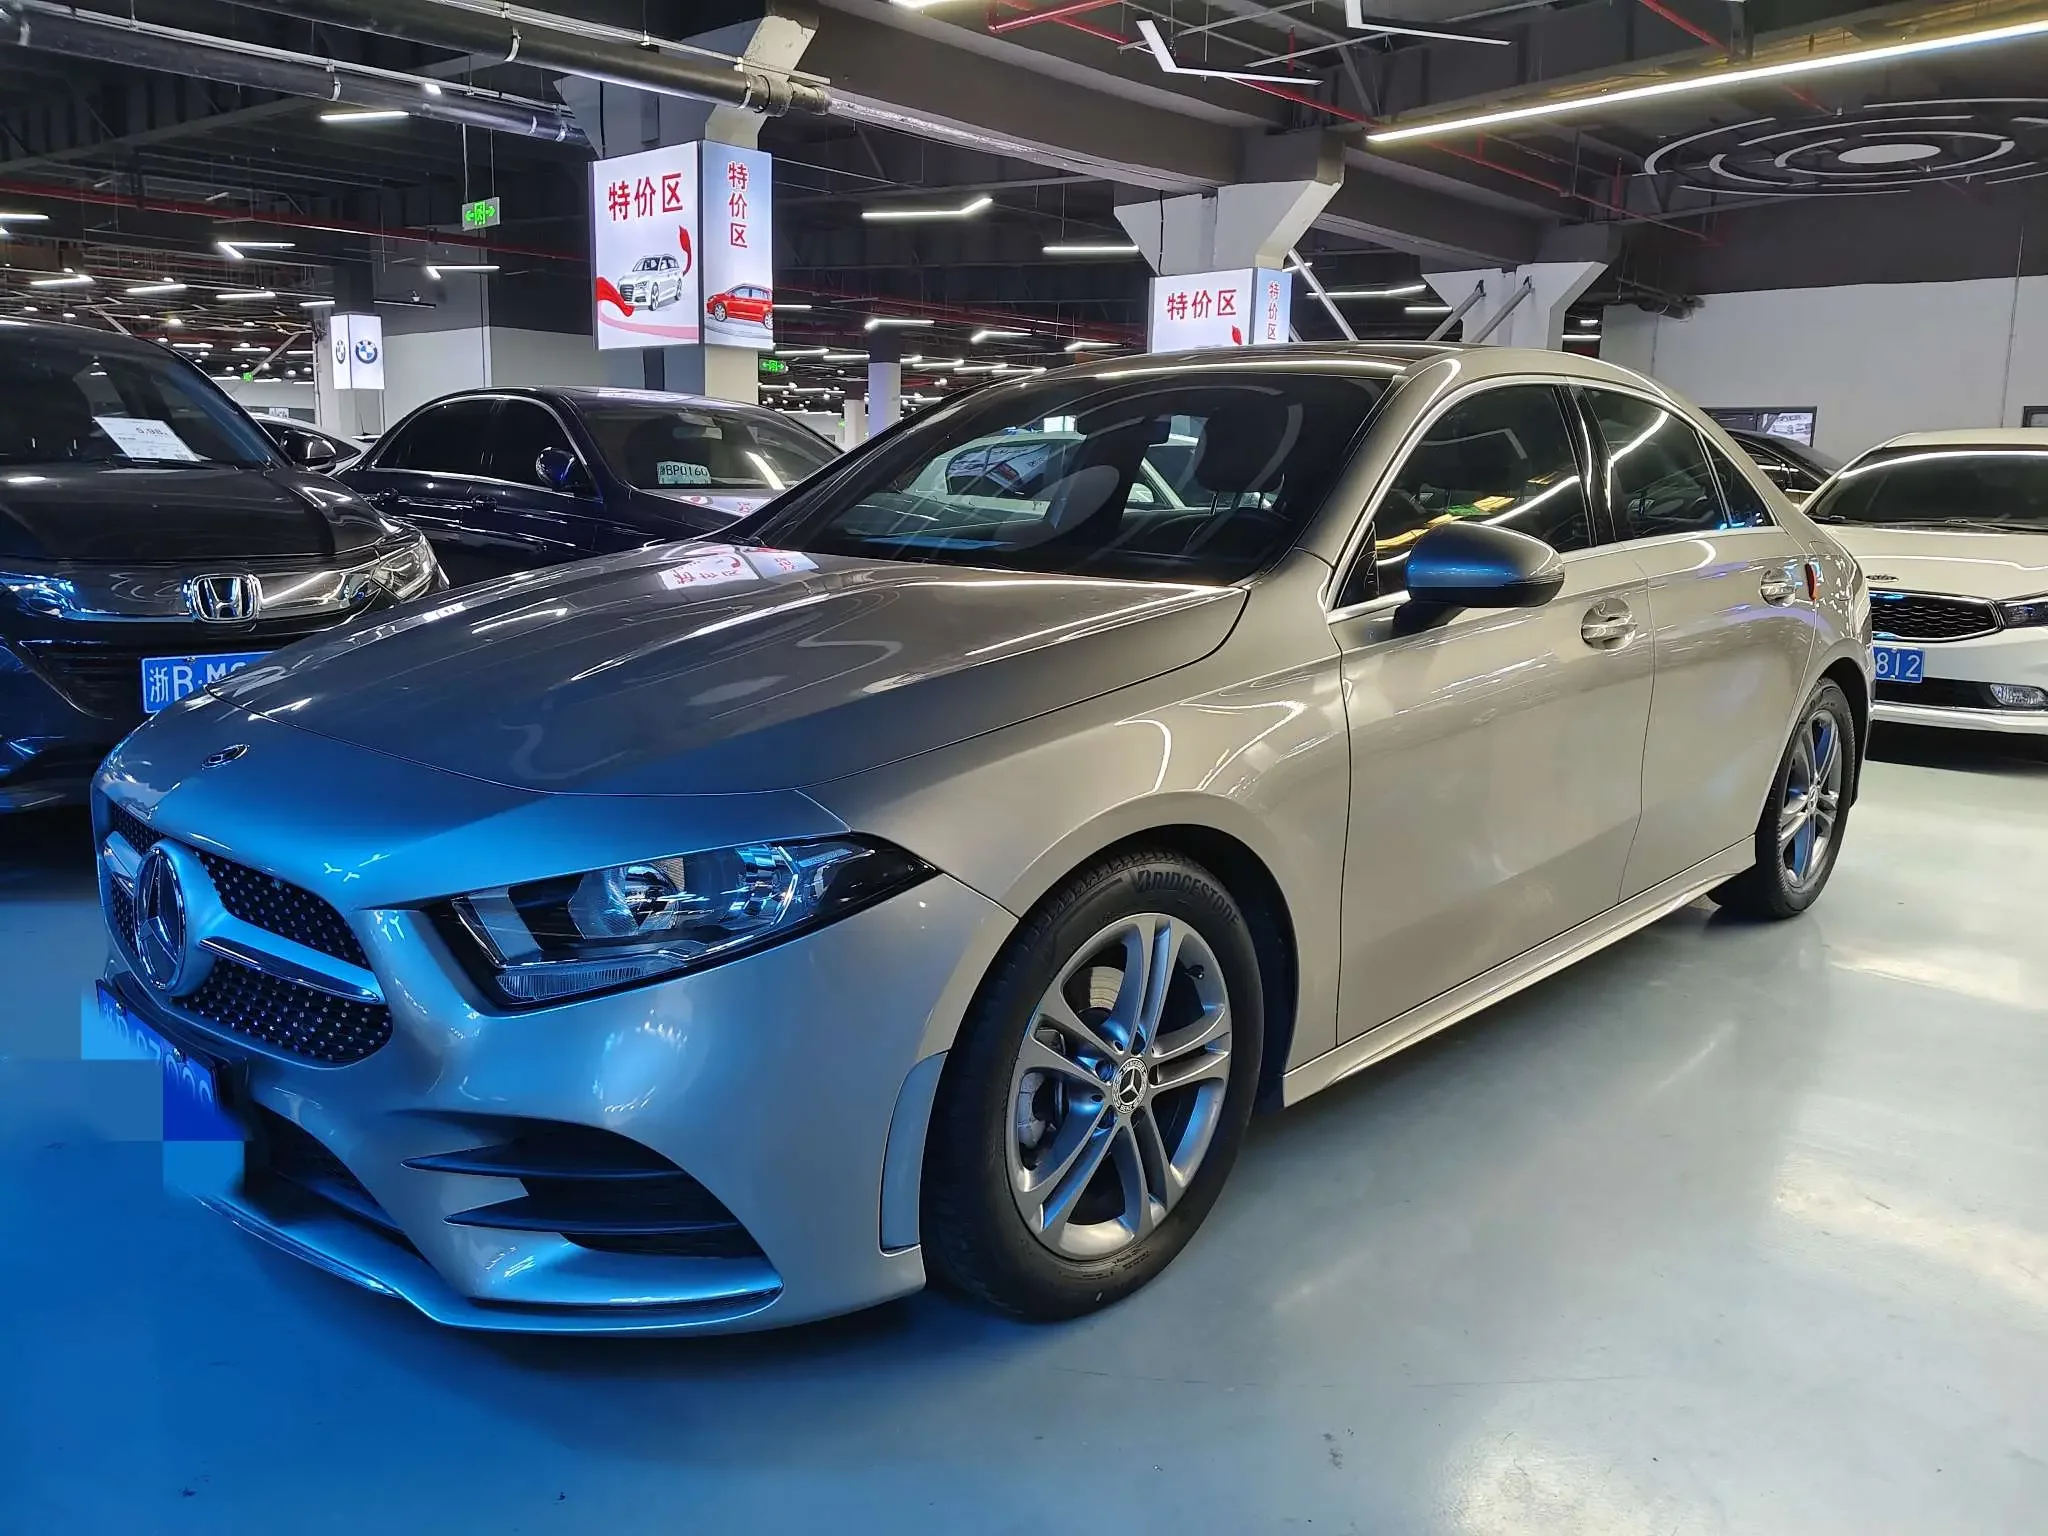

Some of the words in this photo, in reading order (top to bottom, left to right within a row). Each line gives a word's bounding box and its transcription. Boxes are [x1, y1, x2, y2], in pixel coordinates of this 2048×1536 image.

[608, 173, 683, 221] 特价区
[728, 161, 748, 248] 特价区
[1167, 289, 1237, 320] 特价区
[1267, 281, 1280, 340] 特价区
[150, 662, 247, 703] 浙B·M
[1877, 652, 1920, 677] 812
[1133, 869, 1240, 926] BRIDGESTONE
